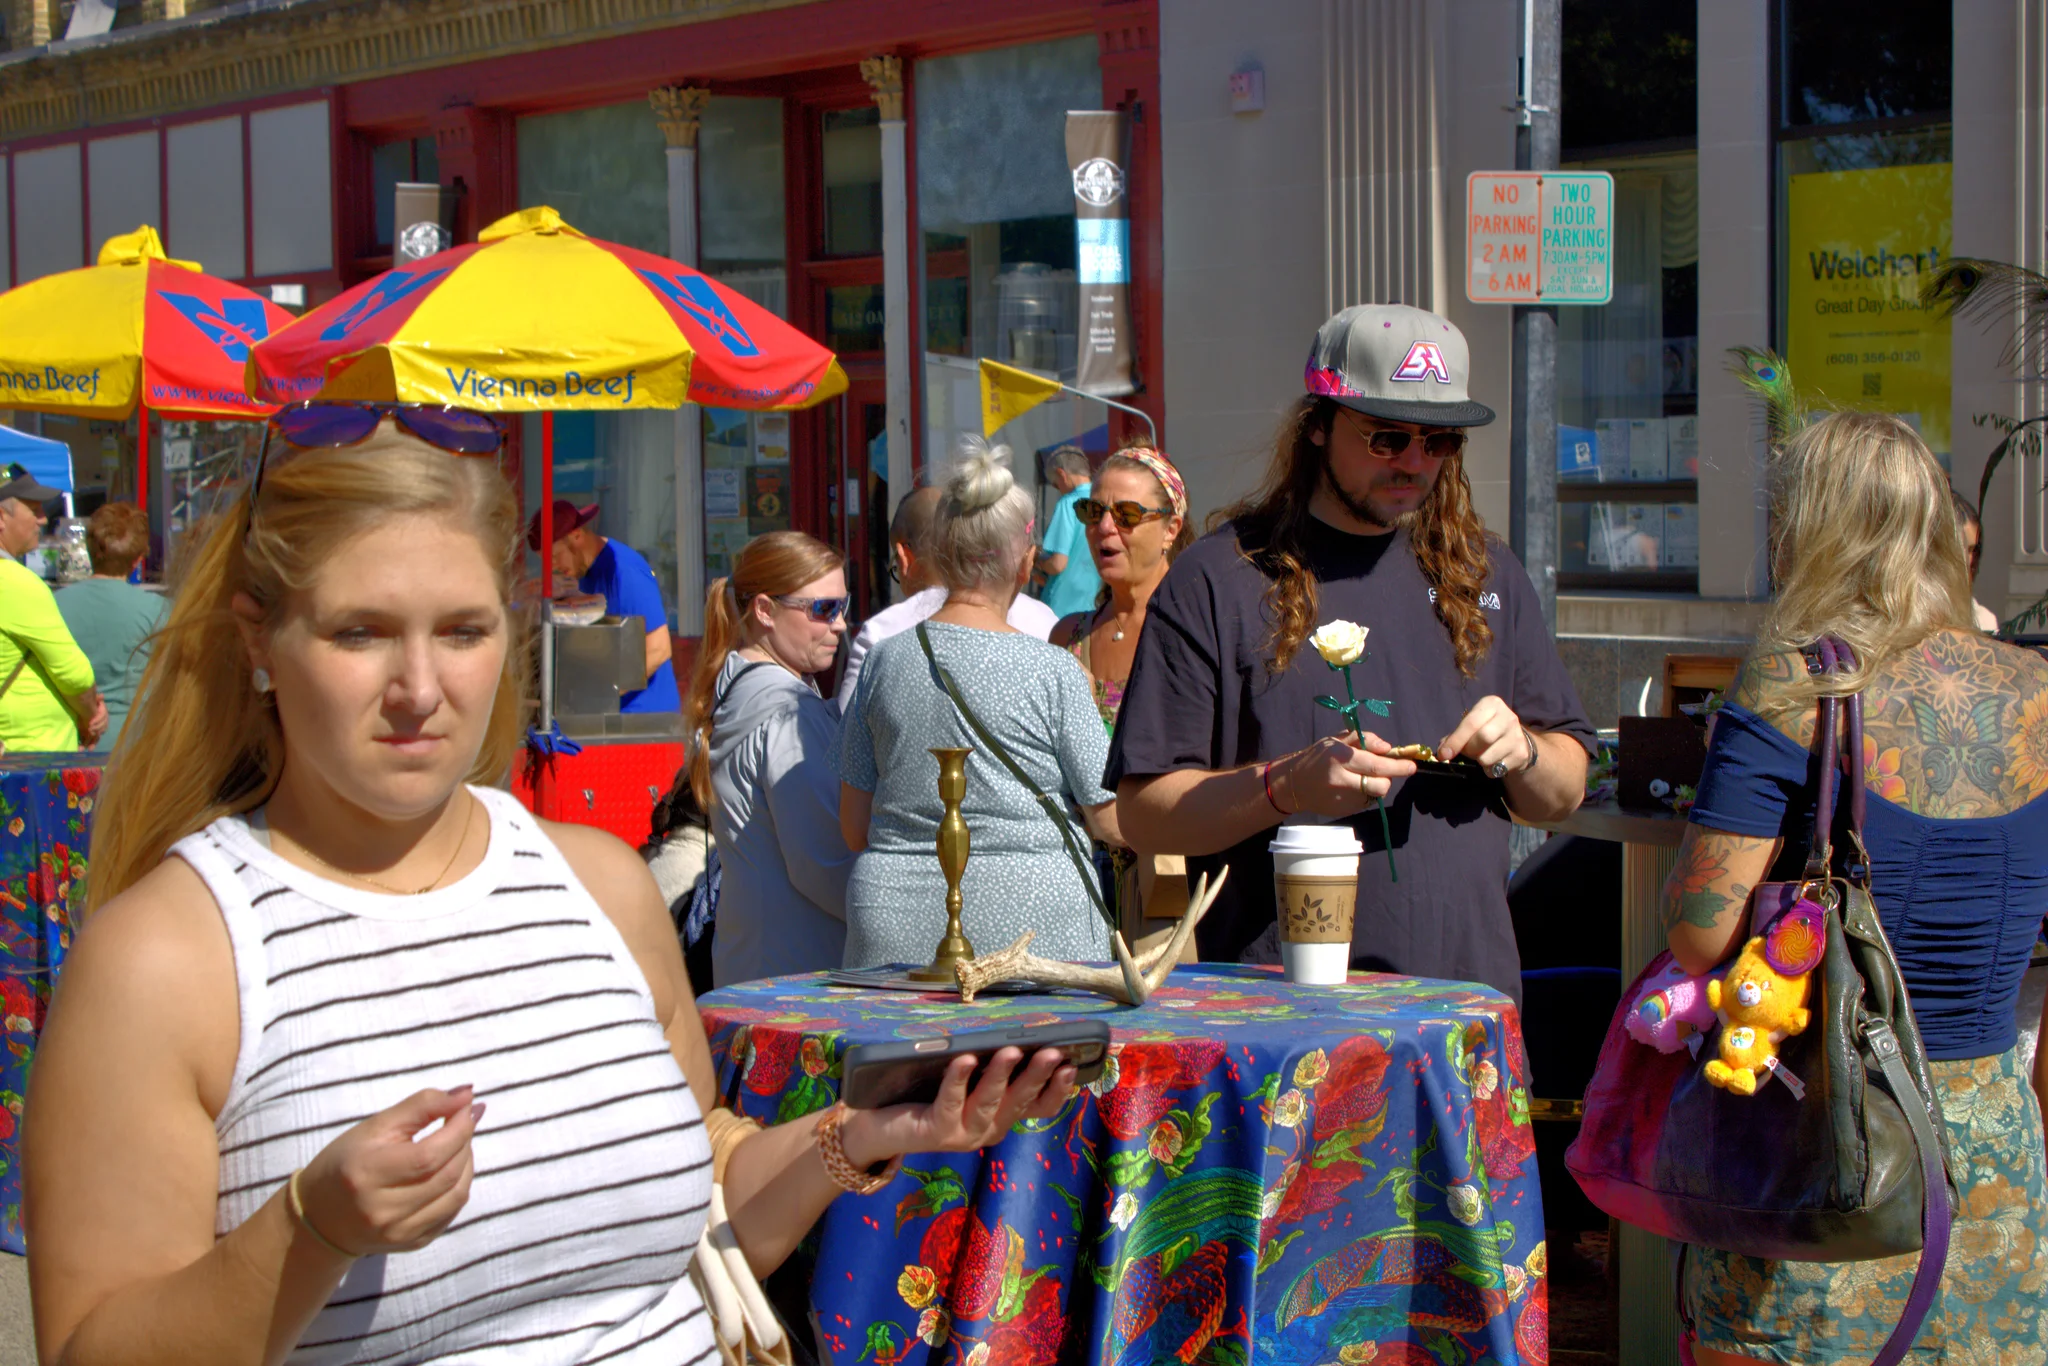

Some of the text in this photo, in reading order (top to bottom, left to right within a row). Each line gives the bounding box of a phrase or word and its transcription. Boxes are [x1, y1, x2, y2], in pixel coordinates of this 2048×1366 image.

[1493, 184, 1519, 204] NO
[1560, 183, 1591, 203] TWO
[1473, 214, 1536, 235] PARKING
[1553, 206, 1596, 225] HOUR
[1543, 228, 1605, 248] PARKING
[1483, 243, 1527, 263] 2 AM
[1557, 266, 1590, 275] EXCEPT
[1809, 246, 1940, 281] Weichert
[1505, 272, 1531, 292] AM
[1541, 284, 1604, 294] LEGAL HOLIDAY
[1570, 275, 1588, 285] SUN
[1815, 298, 1854, 315] Great
[1858, 297, 1886, 316] Day
[1826, 351, 1922, 366] (608) 356-0120
[44, 366, 101, 400] Beef
[446, 367, 637, 403] Vienna Beef
